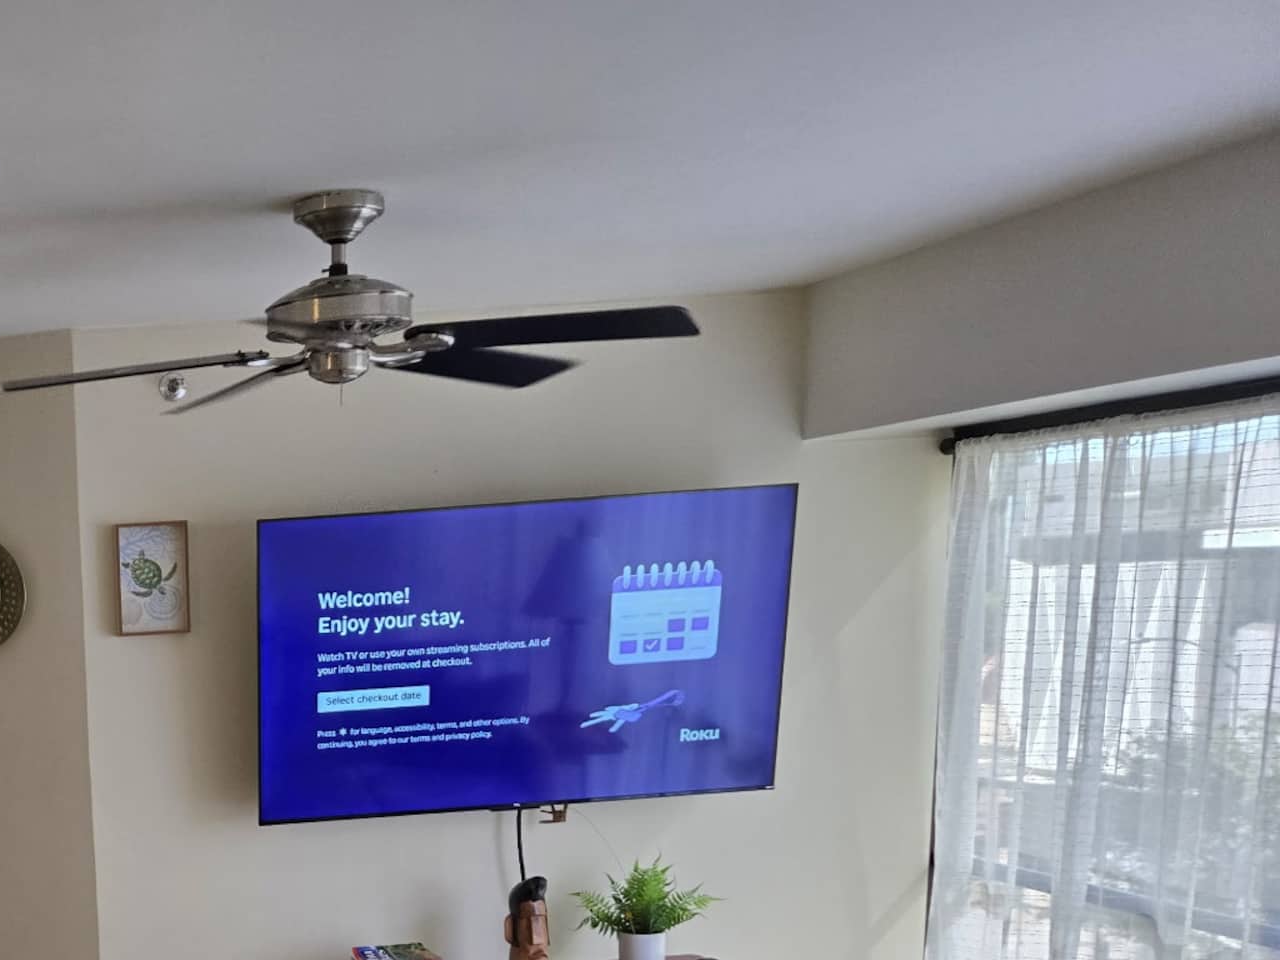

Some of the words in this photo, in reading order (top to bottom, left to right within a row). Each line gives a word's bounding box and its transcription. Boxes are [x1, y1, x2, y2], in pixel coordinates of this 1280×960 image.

[317, 587, 410, 610] Welcome!
[318, 615, 369, 636] Enjoy
[373, 613, 416, 633] your
[420, 609, 464, 628] stay.
[317, 652, 345, 662] Watch
[346, 651, 358, 660] TV
[369, 651, 385, 659] use
[386, 649, 406, 659] your
[407, 648, 425, 656] own
[426, 644, 469, 654] streaming
[470, 641, 527, 652] subscriptions.
[528, 638, 540, 648] All
[540, 637, 551, 647] of
[317, 666, 337, 677] your
[338, 664, 355, 674] info
[356, 663, 371, 672] will
[371, 662, 383, 672] be
[383, 660, 421, 671] removed
[422, 660, 431, 668] at
[431, 657, 473, 667] checkout.
[326, 695, 354, 706] Select
[357, 693, 399, 704] checkout
[400, 691, 422, 701] date
